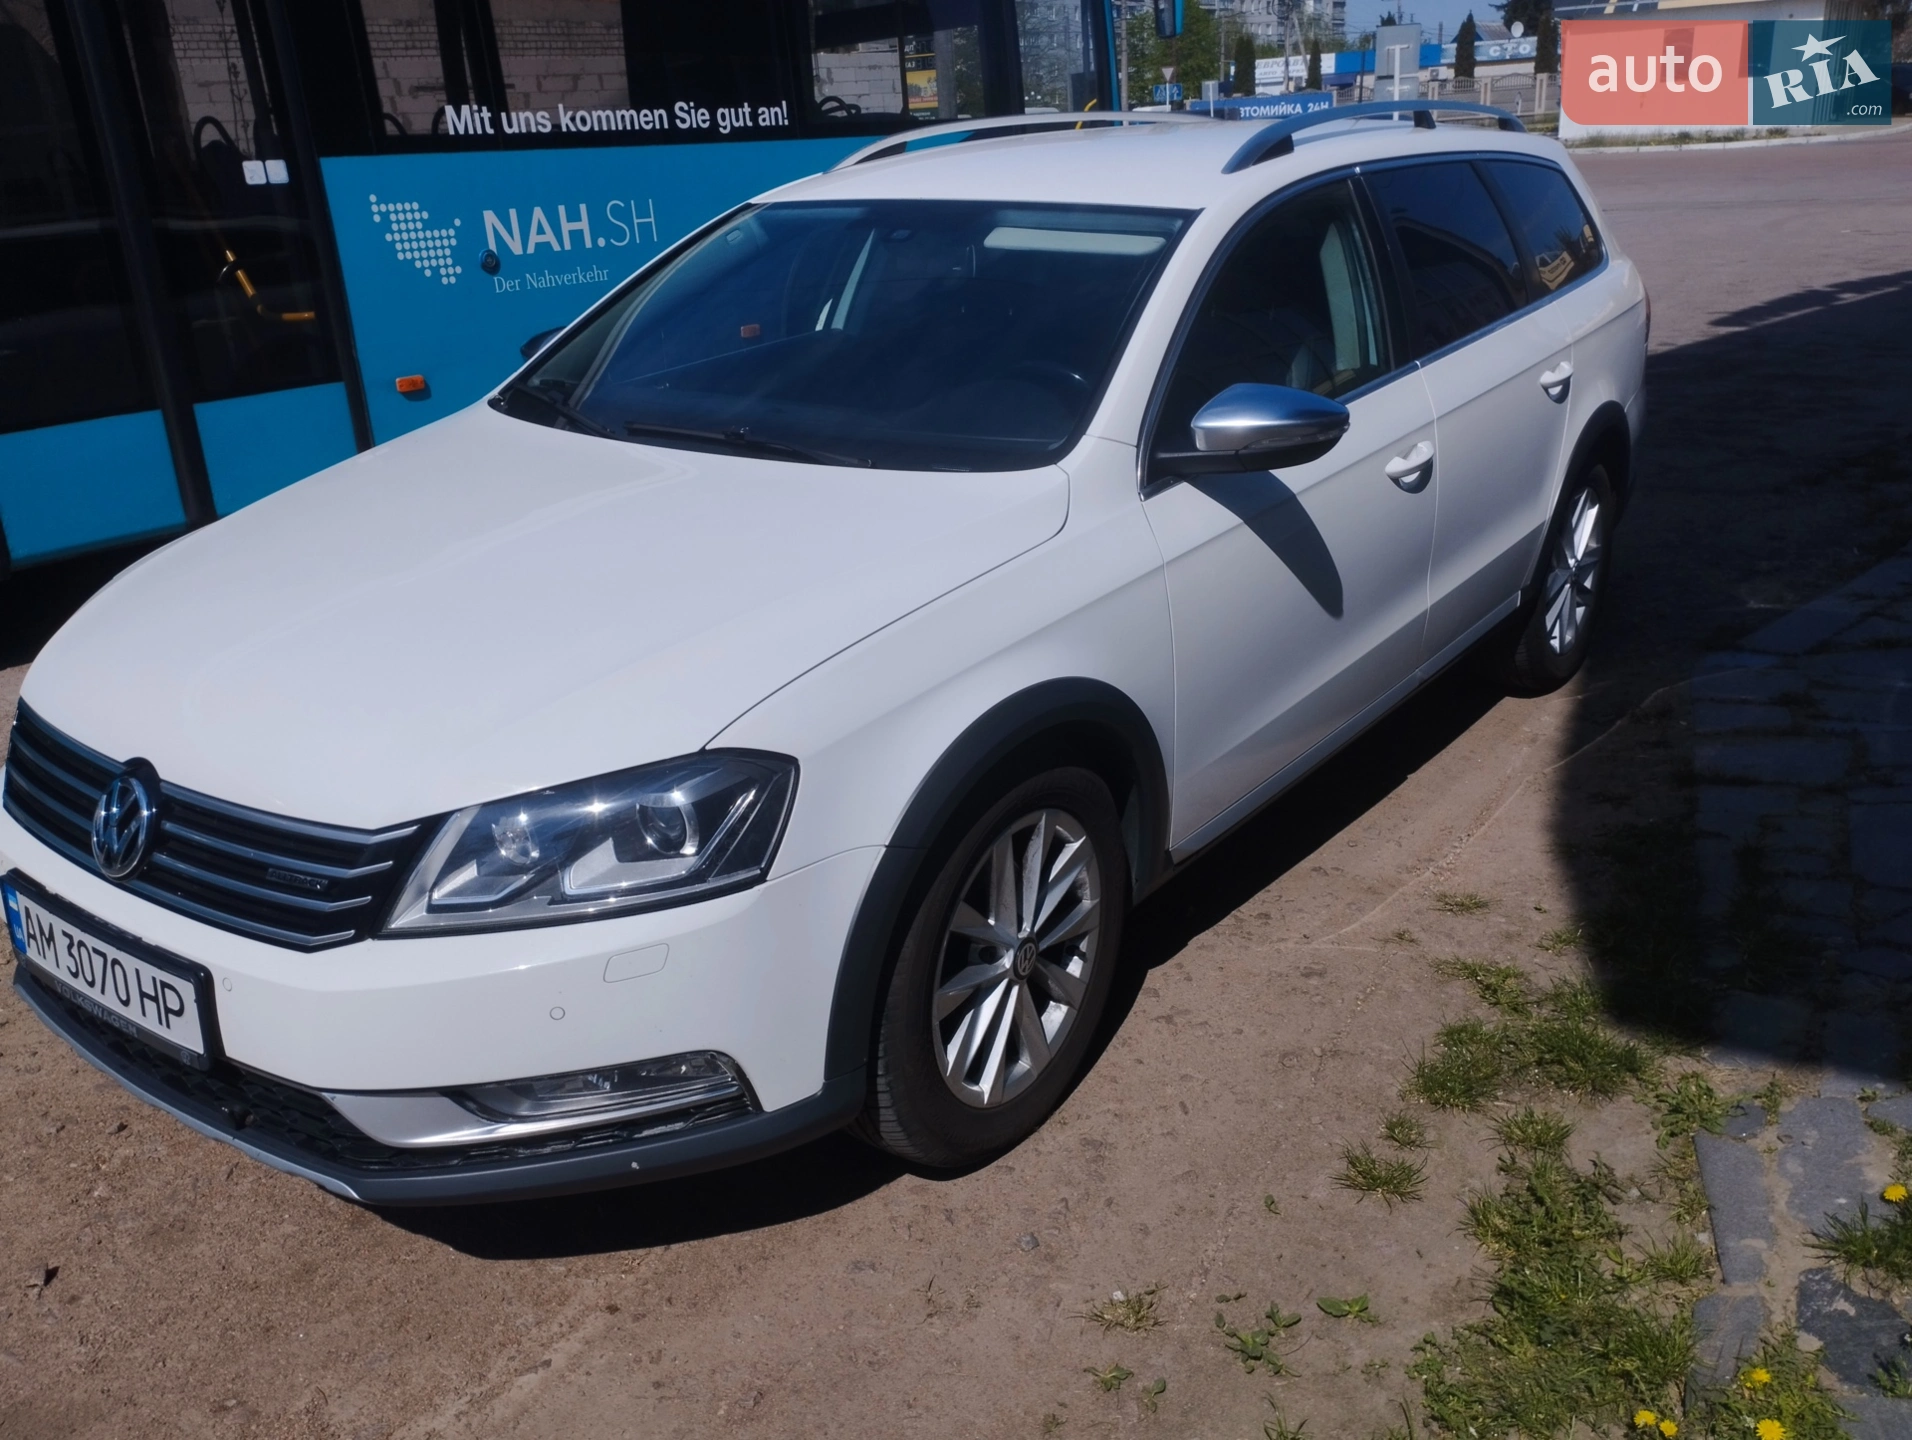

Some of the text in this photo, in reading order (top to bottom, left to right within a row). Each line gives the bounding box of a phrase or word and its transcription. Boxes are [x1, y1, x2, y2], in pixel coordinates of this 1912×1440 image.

[444, 100, 789, 135] Mit uns kommen Sie gut an!
[1240, 102, 1302, 117] ВТОМИЙКА
[482, 199, 658, 255] NAH.SH
[493, 265, 609, 293] Der Nahverkehr
[13, 923, 25, 943] UA
[24, 905, 185, 1030] AM 3070 HP
[55, 980, 138, 1038] VOLKSWAGEN
